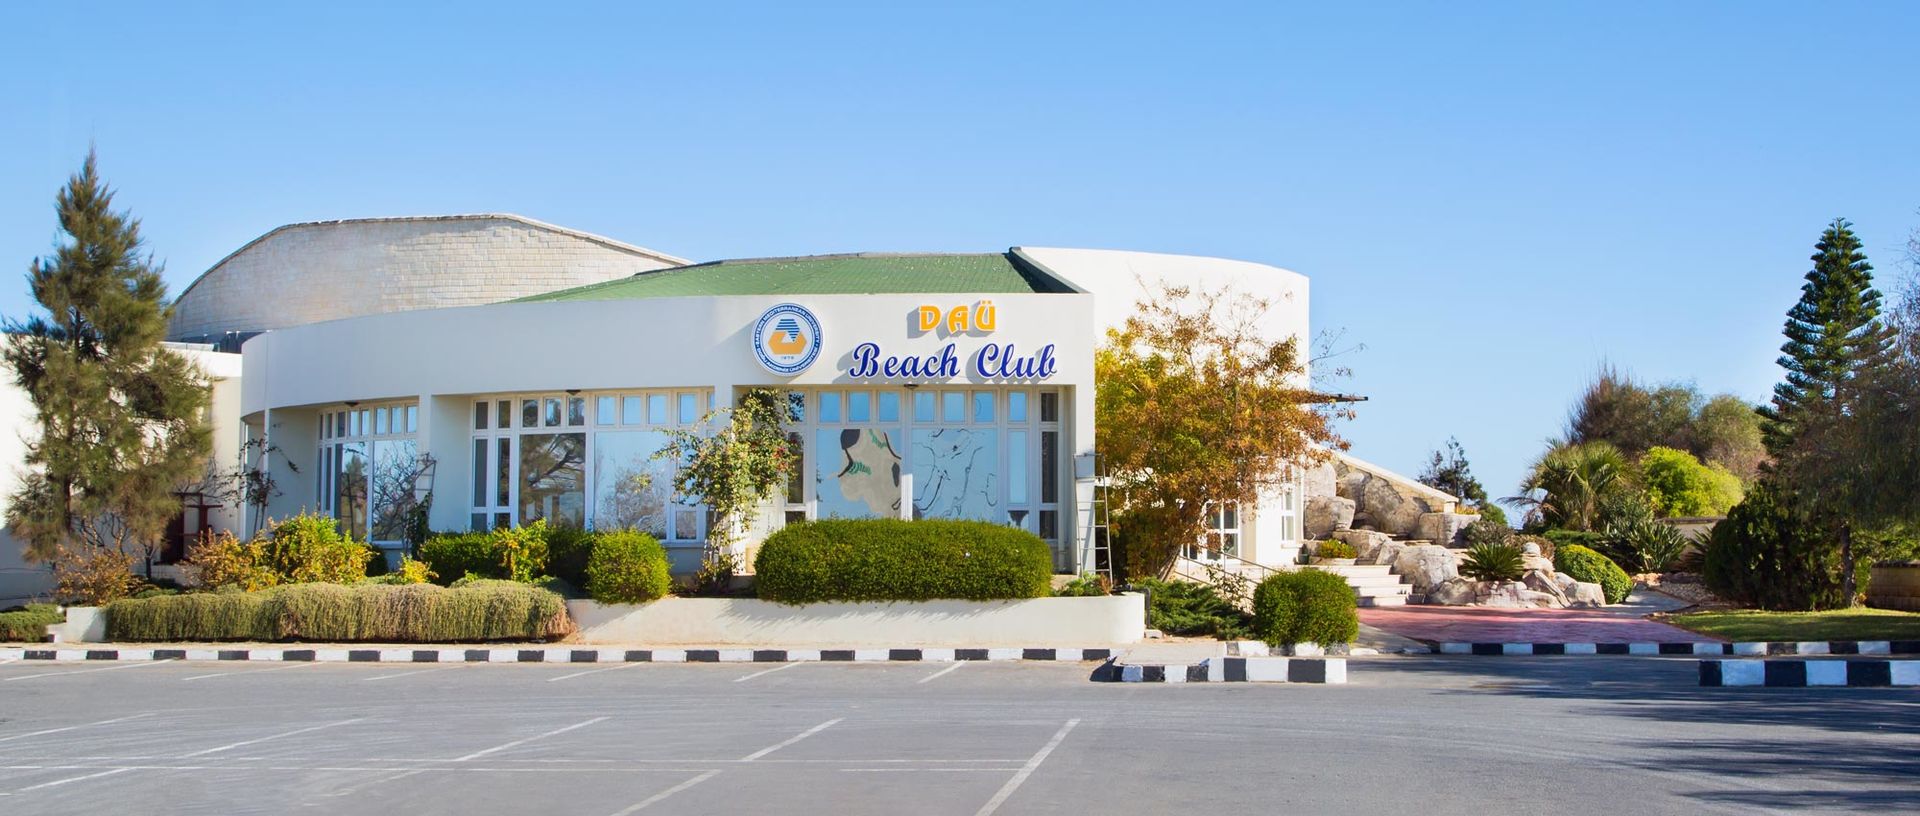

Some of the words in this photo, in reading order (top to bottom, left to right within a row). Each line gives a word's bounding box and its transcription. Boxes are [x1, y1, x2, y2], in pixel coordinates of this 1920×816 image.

[919, 300, 996, 333] DAÜ
[849, 342, 960, 378] Beach
[976, 343, 1057, 378] Club
